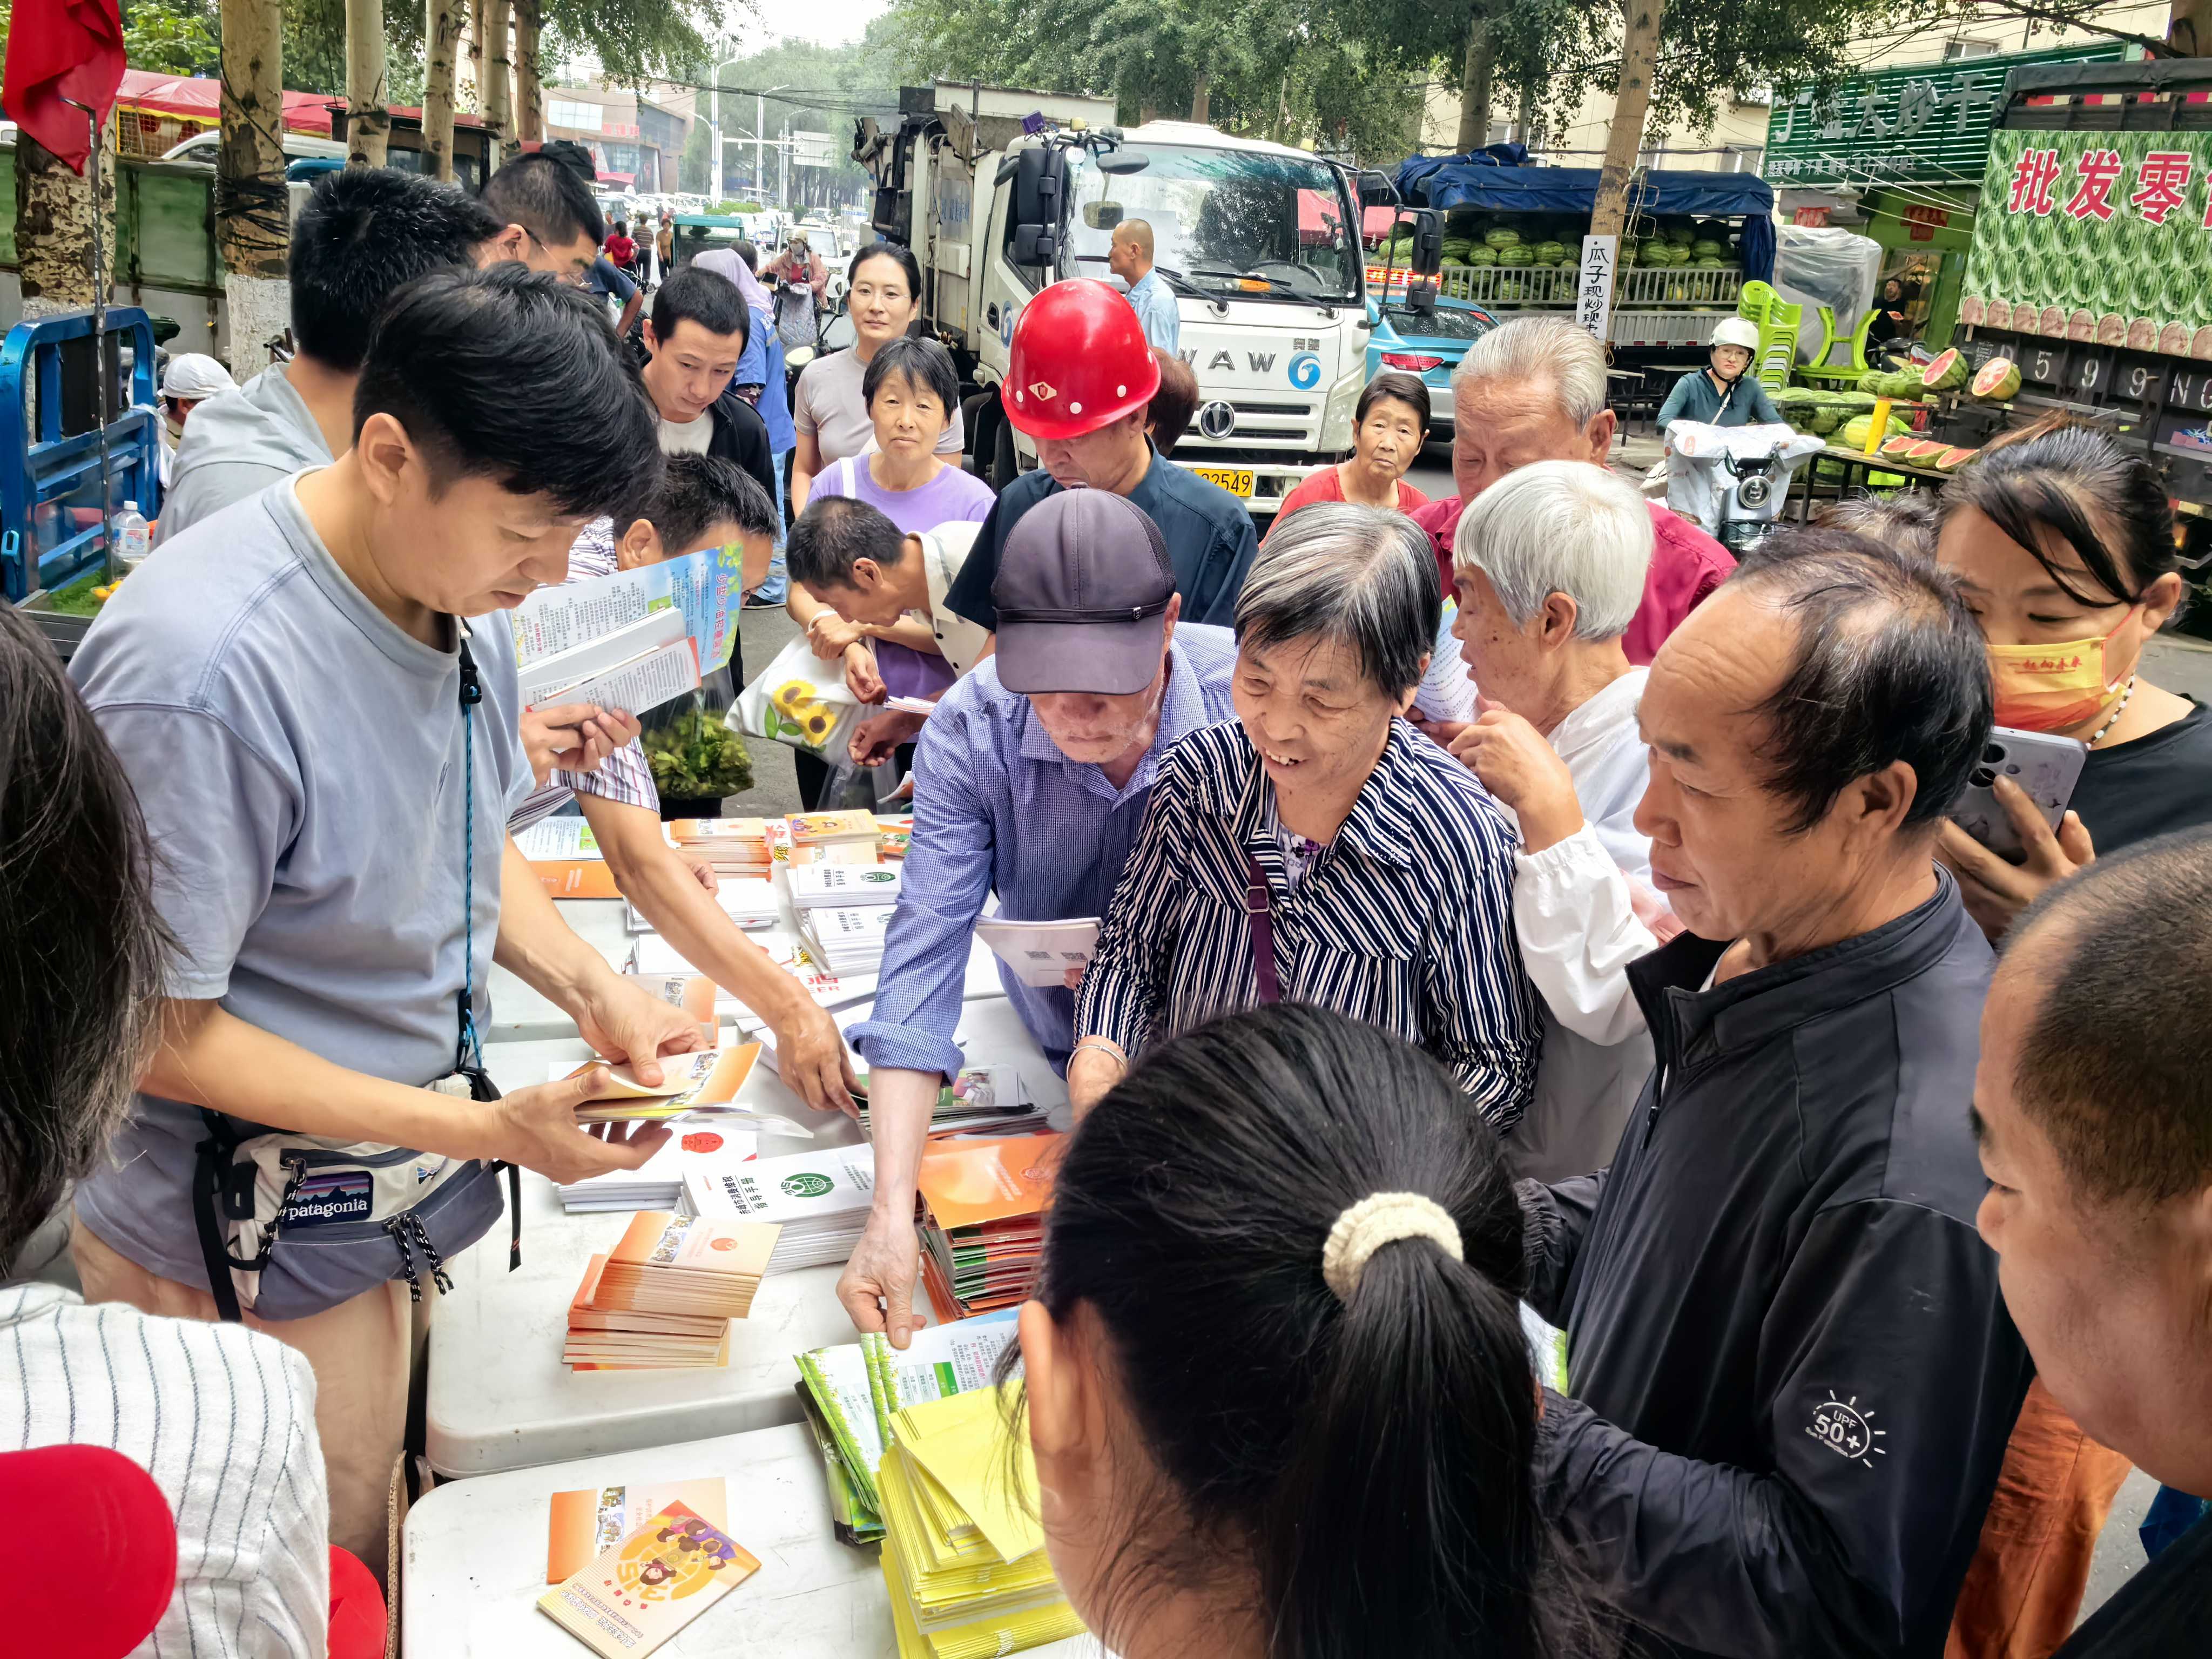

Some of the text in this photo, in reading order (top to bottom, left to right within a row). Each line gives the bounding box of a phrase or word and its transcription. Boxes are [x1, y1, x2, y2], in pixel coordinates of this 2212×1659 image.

[2007, 146, 2212, 231] 批发零
[289, 1198, 367, 1220] patagonia
[1813, 1413, 1861, 1449] 50+
[1833, 1410, 1858, 1428] UPF
